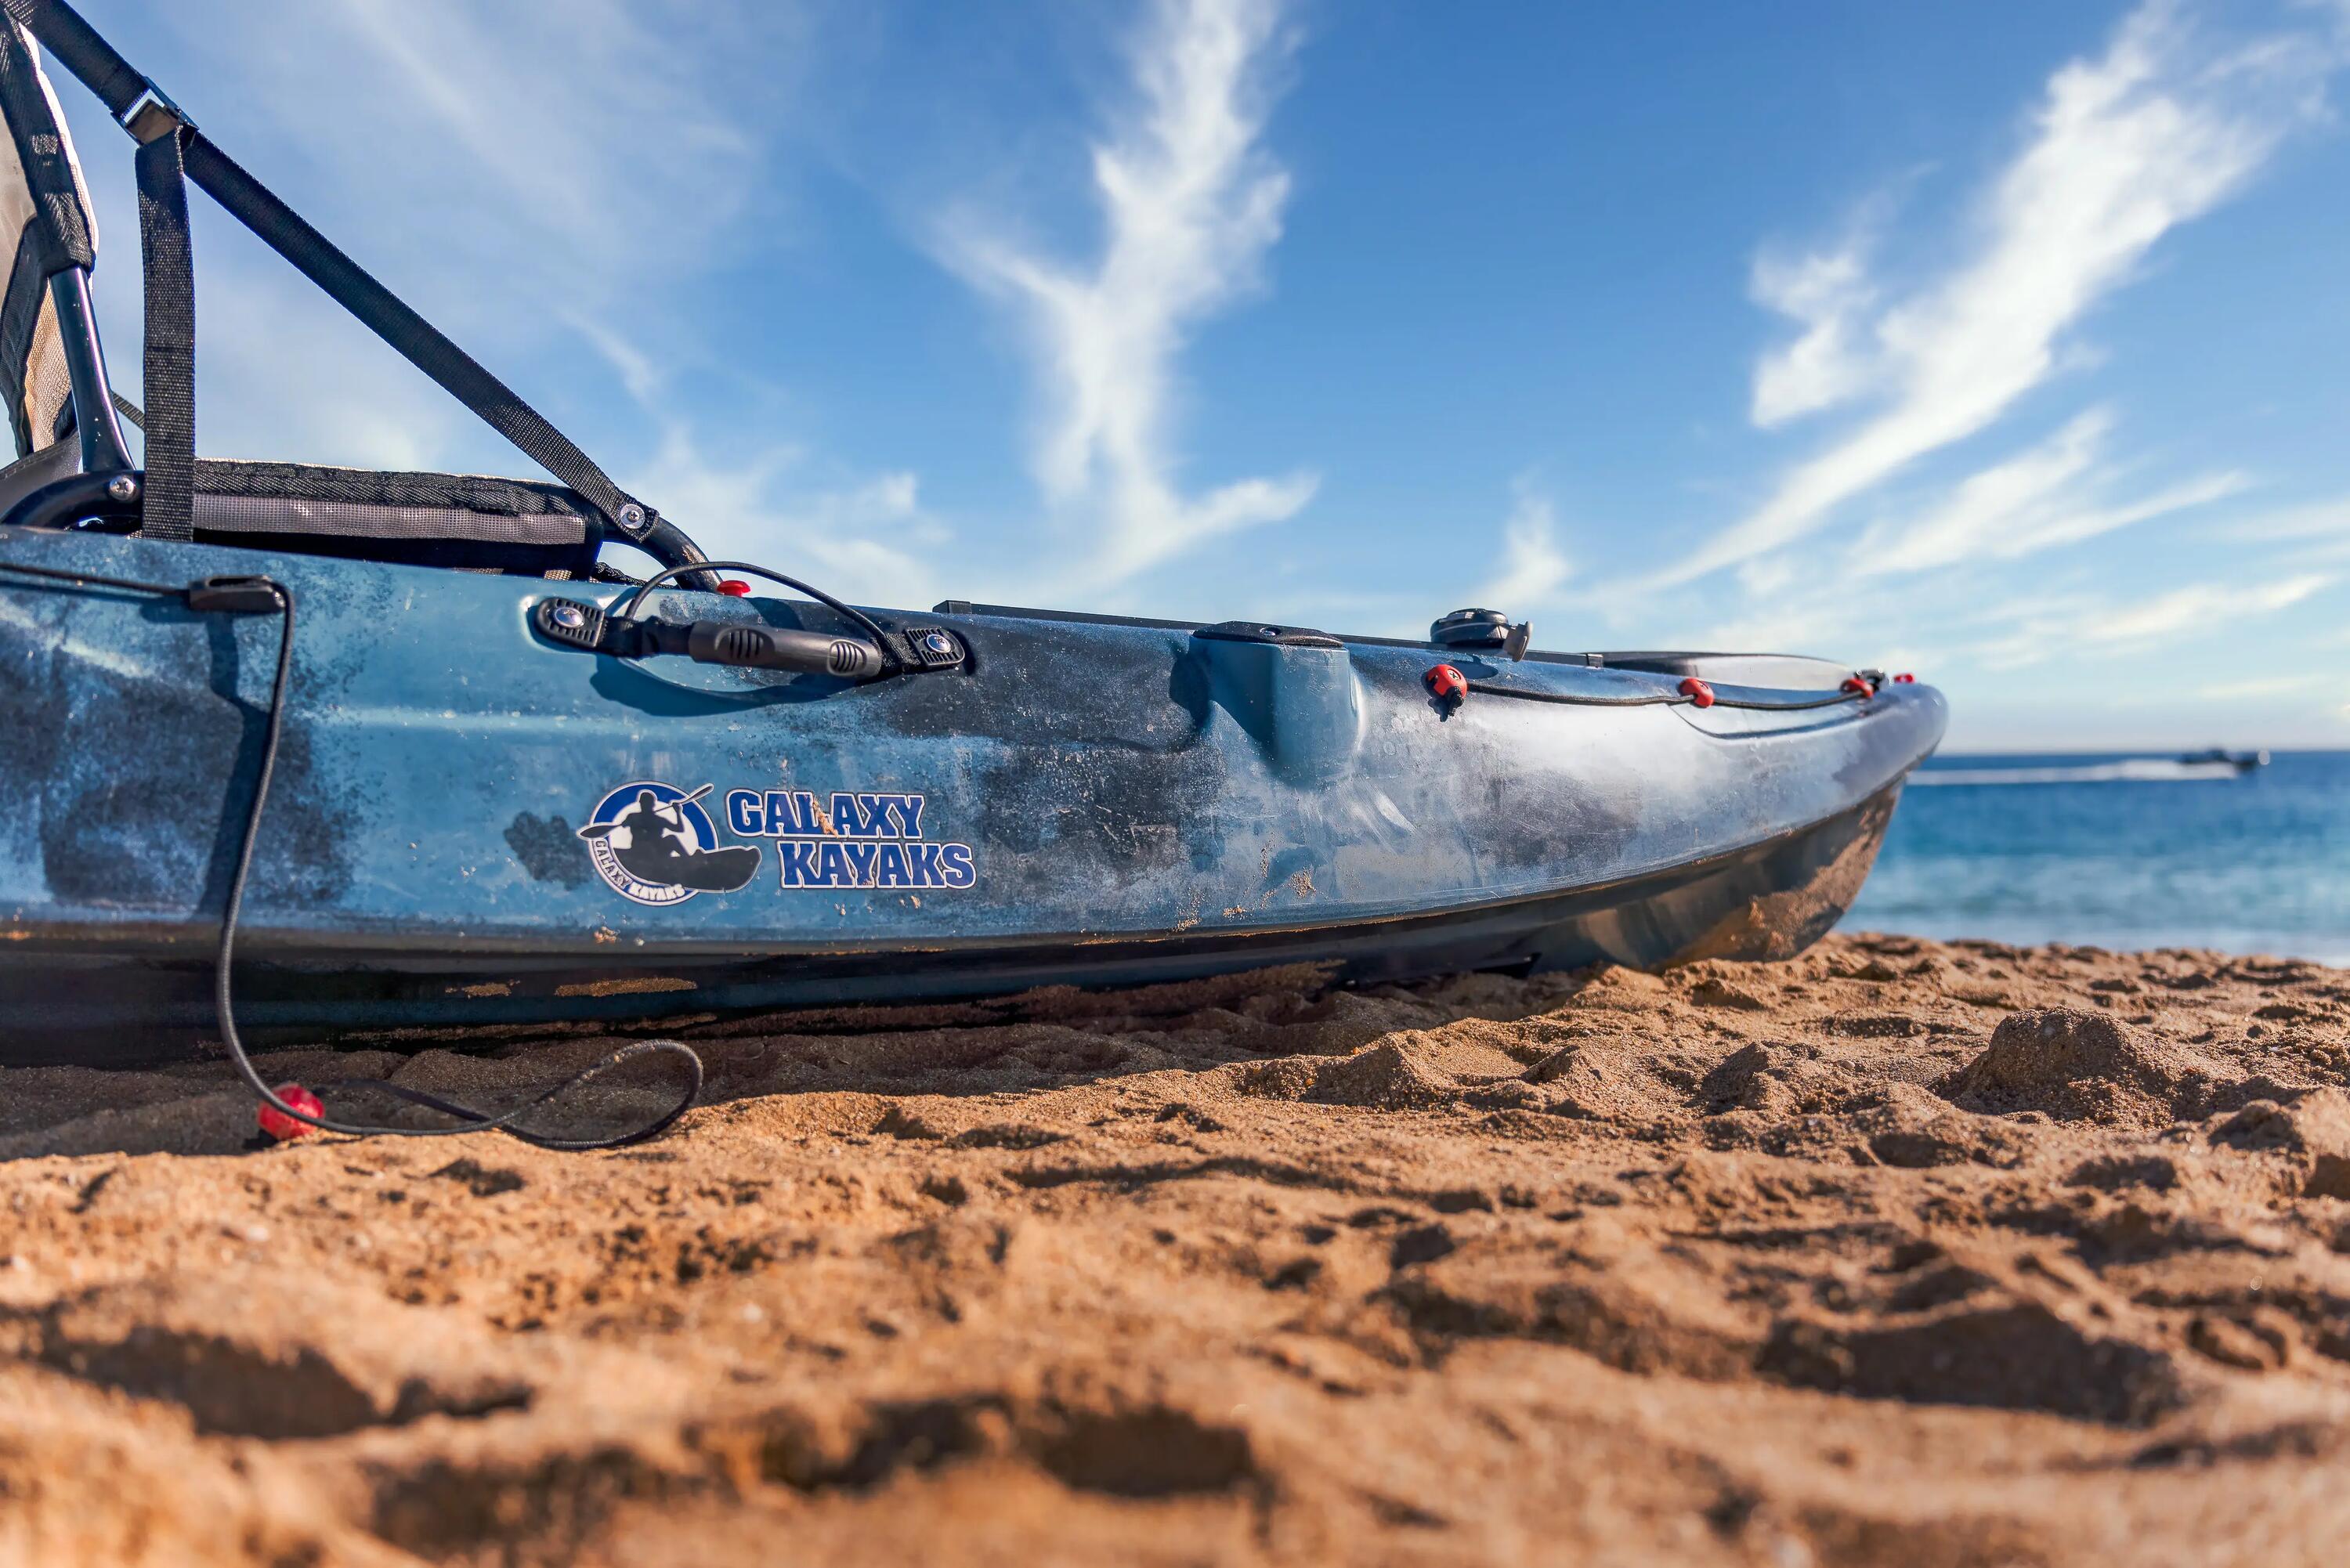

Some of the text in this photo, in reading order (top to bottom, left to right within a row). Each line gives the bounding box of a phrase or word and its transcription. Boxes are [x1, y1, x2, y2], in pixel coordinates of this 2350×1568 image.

[726, 789, 924, 838] GALAXY
[595, 838, 685, 901] GALAXY KAYAKS
[778, 840, 977, 889] KAYAKS
